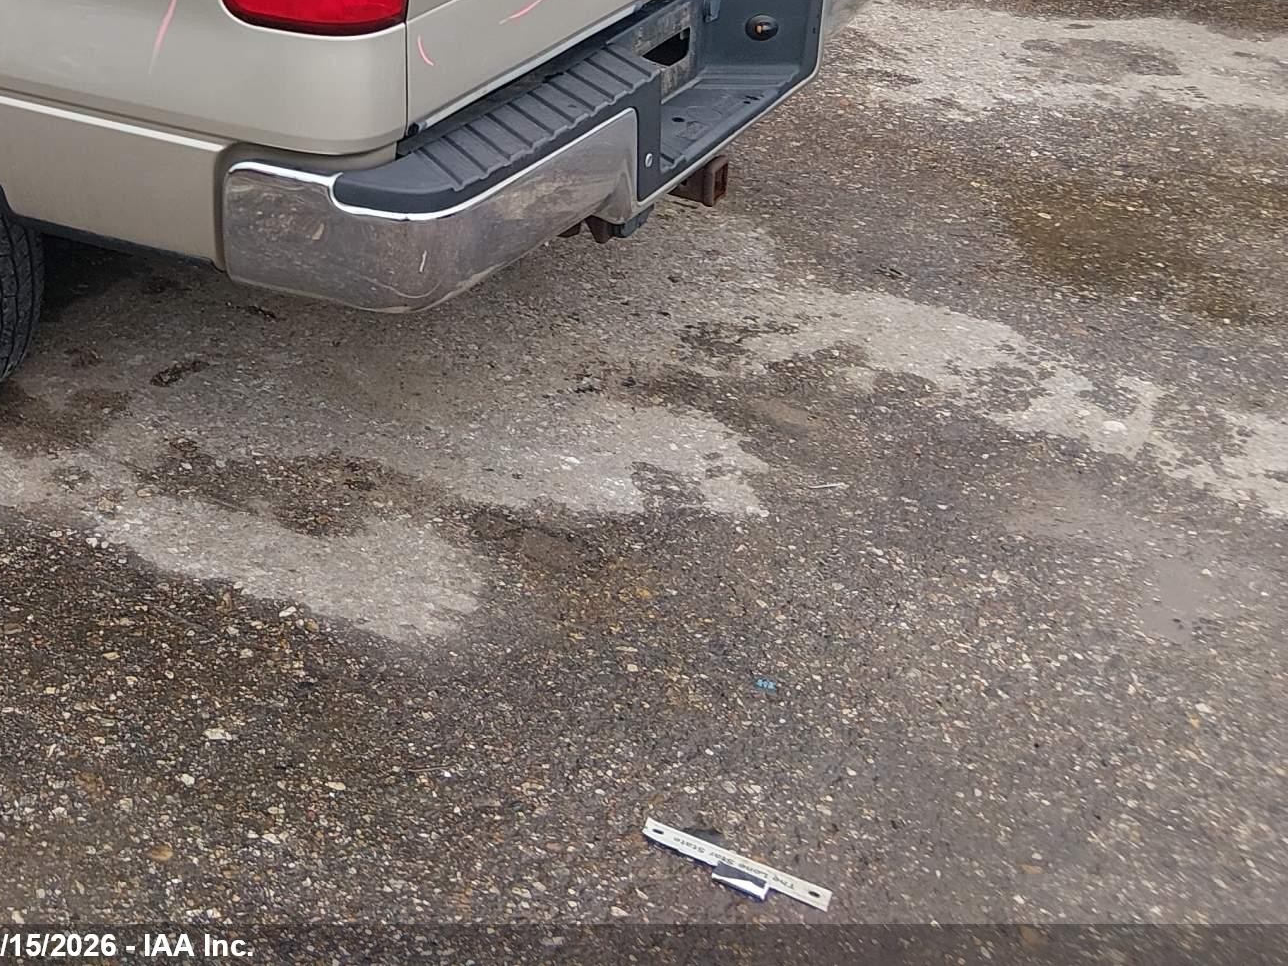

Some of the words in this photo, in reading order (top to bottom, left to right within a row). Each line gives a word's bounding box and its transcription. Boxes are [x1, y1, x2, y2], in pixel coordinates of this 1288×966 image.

[673, 837, 706, 853] State
[709, 851, 735, 865] Star
[738, 863, 768, 879] Lone
[772, 874, 795, 890] The
